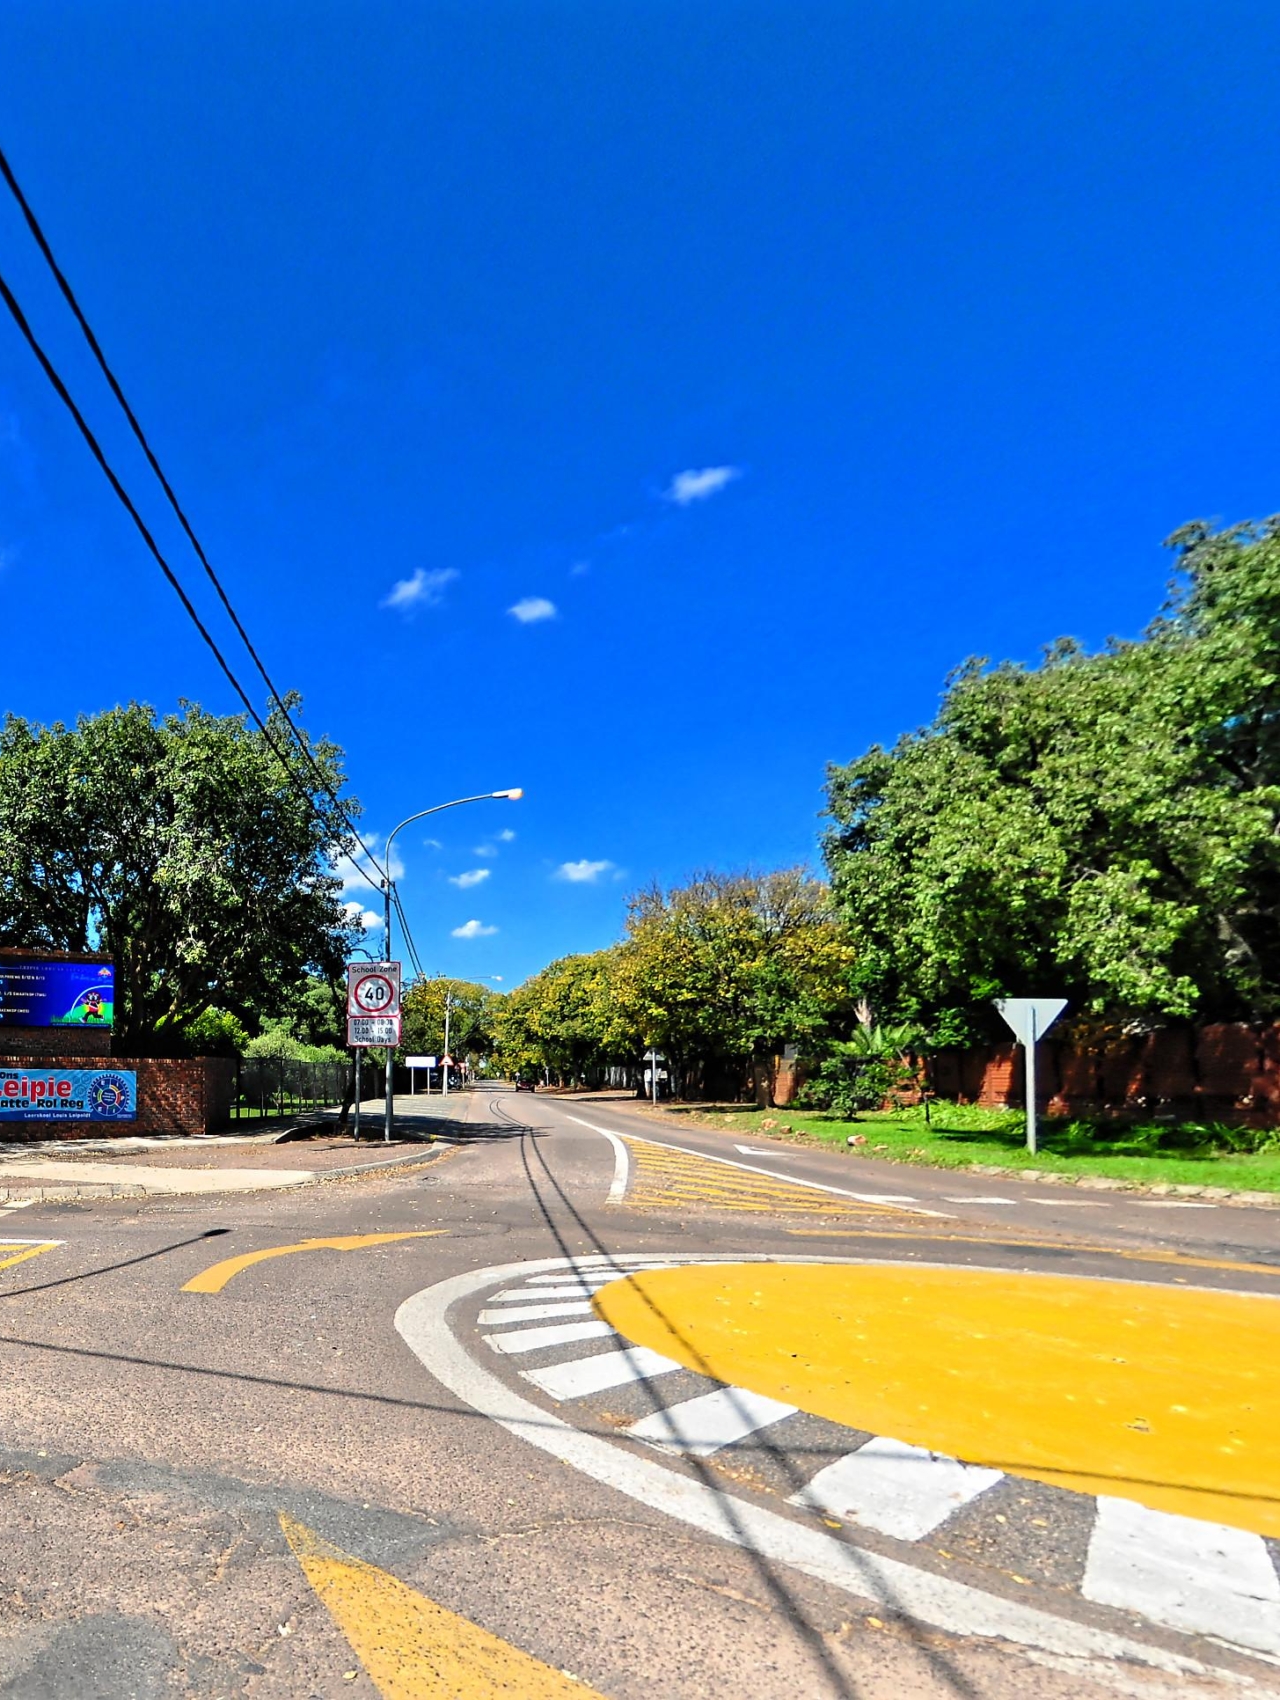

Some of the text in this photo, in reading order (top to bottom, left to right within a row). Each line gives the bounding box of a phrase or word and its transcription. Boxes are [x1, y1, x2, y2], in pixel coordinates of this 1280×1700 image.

[365, 987, 385, 1001] 40
[377, 1036, 391, 1044] Days
[37, 1099, 57, 1108] Rol
[60, 1099, 85, 1109] Reg
